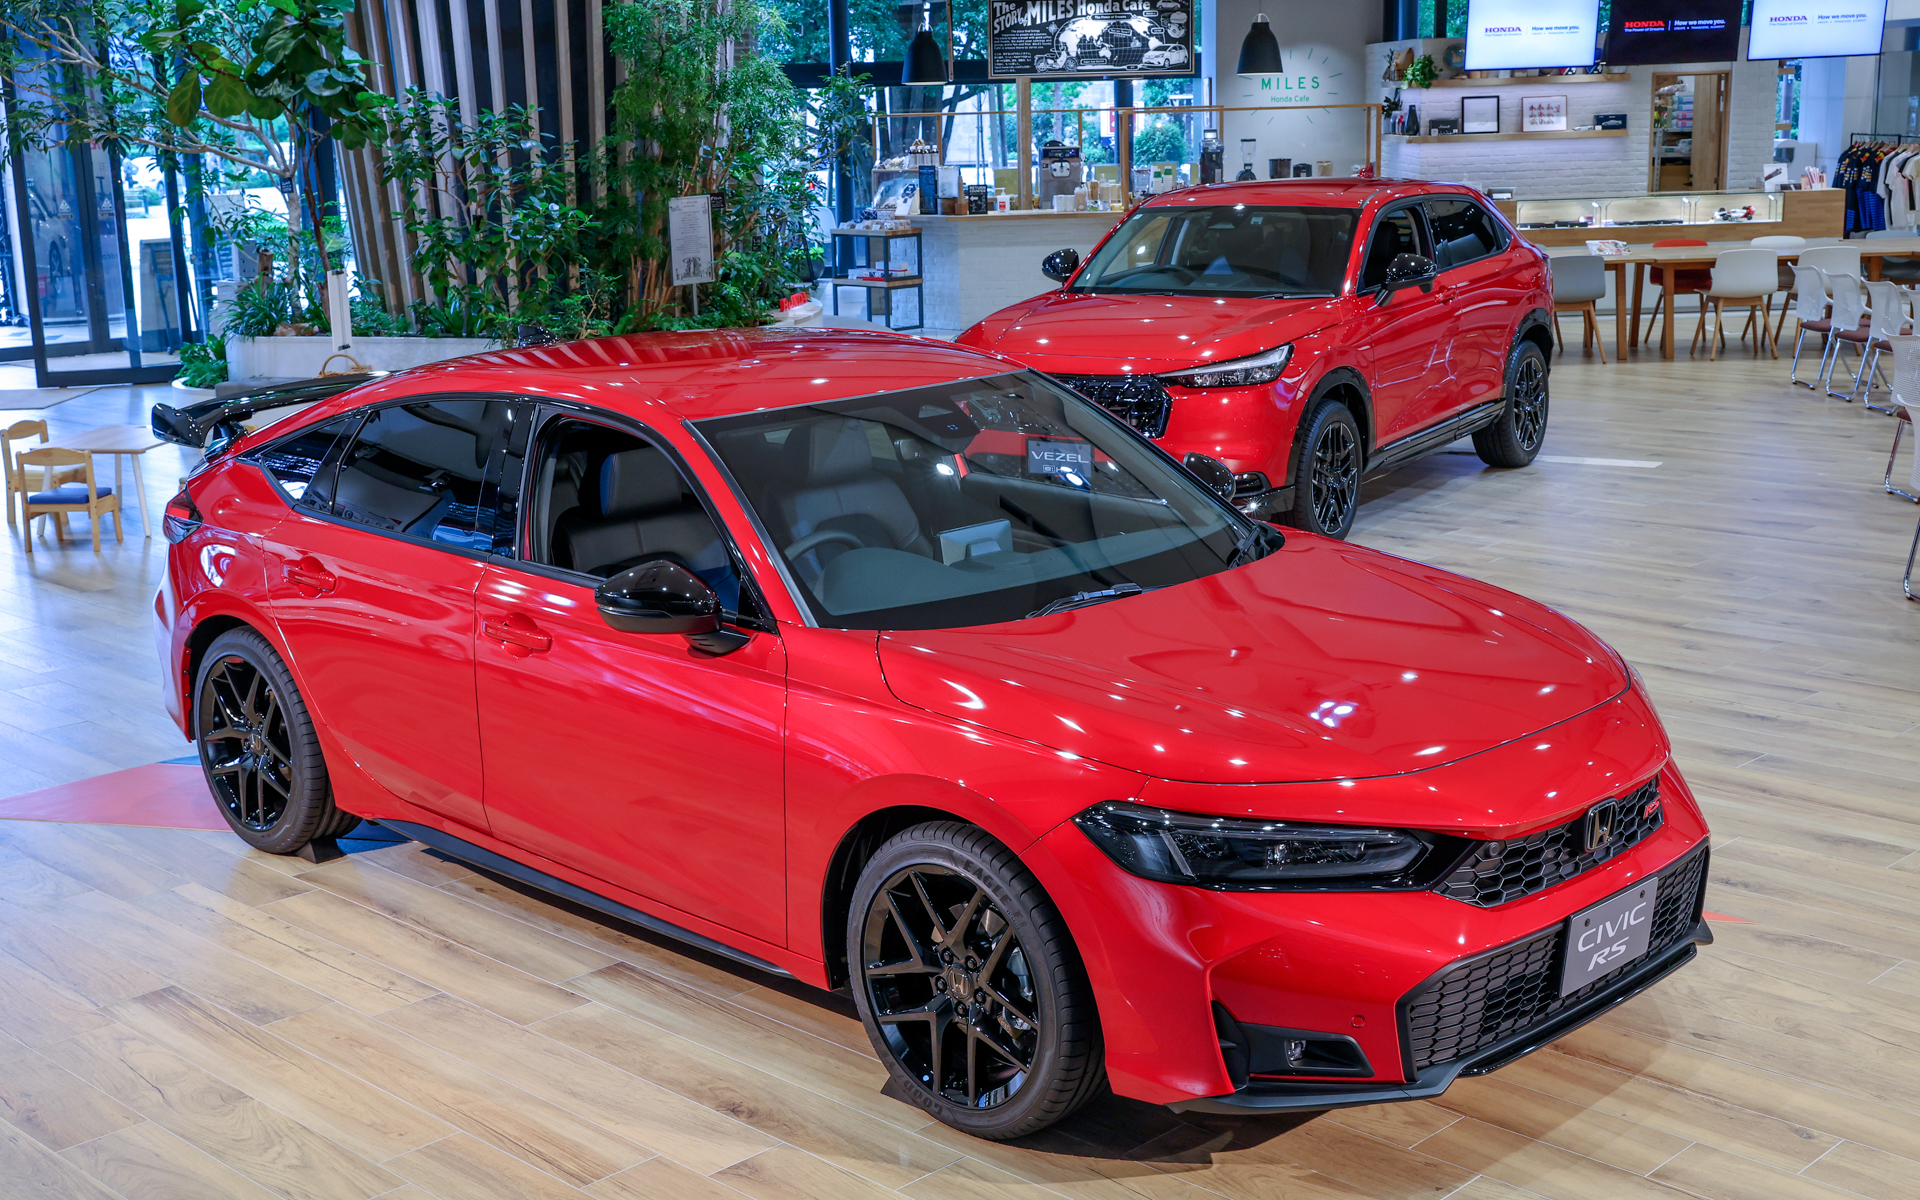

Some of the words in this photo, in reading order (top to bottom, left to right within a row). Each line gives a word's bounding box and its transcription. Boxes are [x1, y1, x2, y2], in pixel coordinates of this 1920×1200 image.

[993, 2, 1016, 18] The
[993, 7, 1023, 34] STORY
[1018, 13, 1028, 27] of
[1026, 0, 1074, 26] MILES
[1076, 0, 1121, 16] Honda
[1122, 0, 1151, 11] Cafe
[1261, 76, 1320, 90] MILES
[1294, 95, 1310, 103] Cafe
[1031, 451, 1089, 464] VEZEL
[1643, 796, 1661, 818] RS
[962, 859, 1012, 906] EAGLE
[1578, 902, 1647, 953] CIVIC
[1587, 936, 1630, 972] RS
